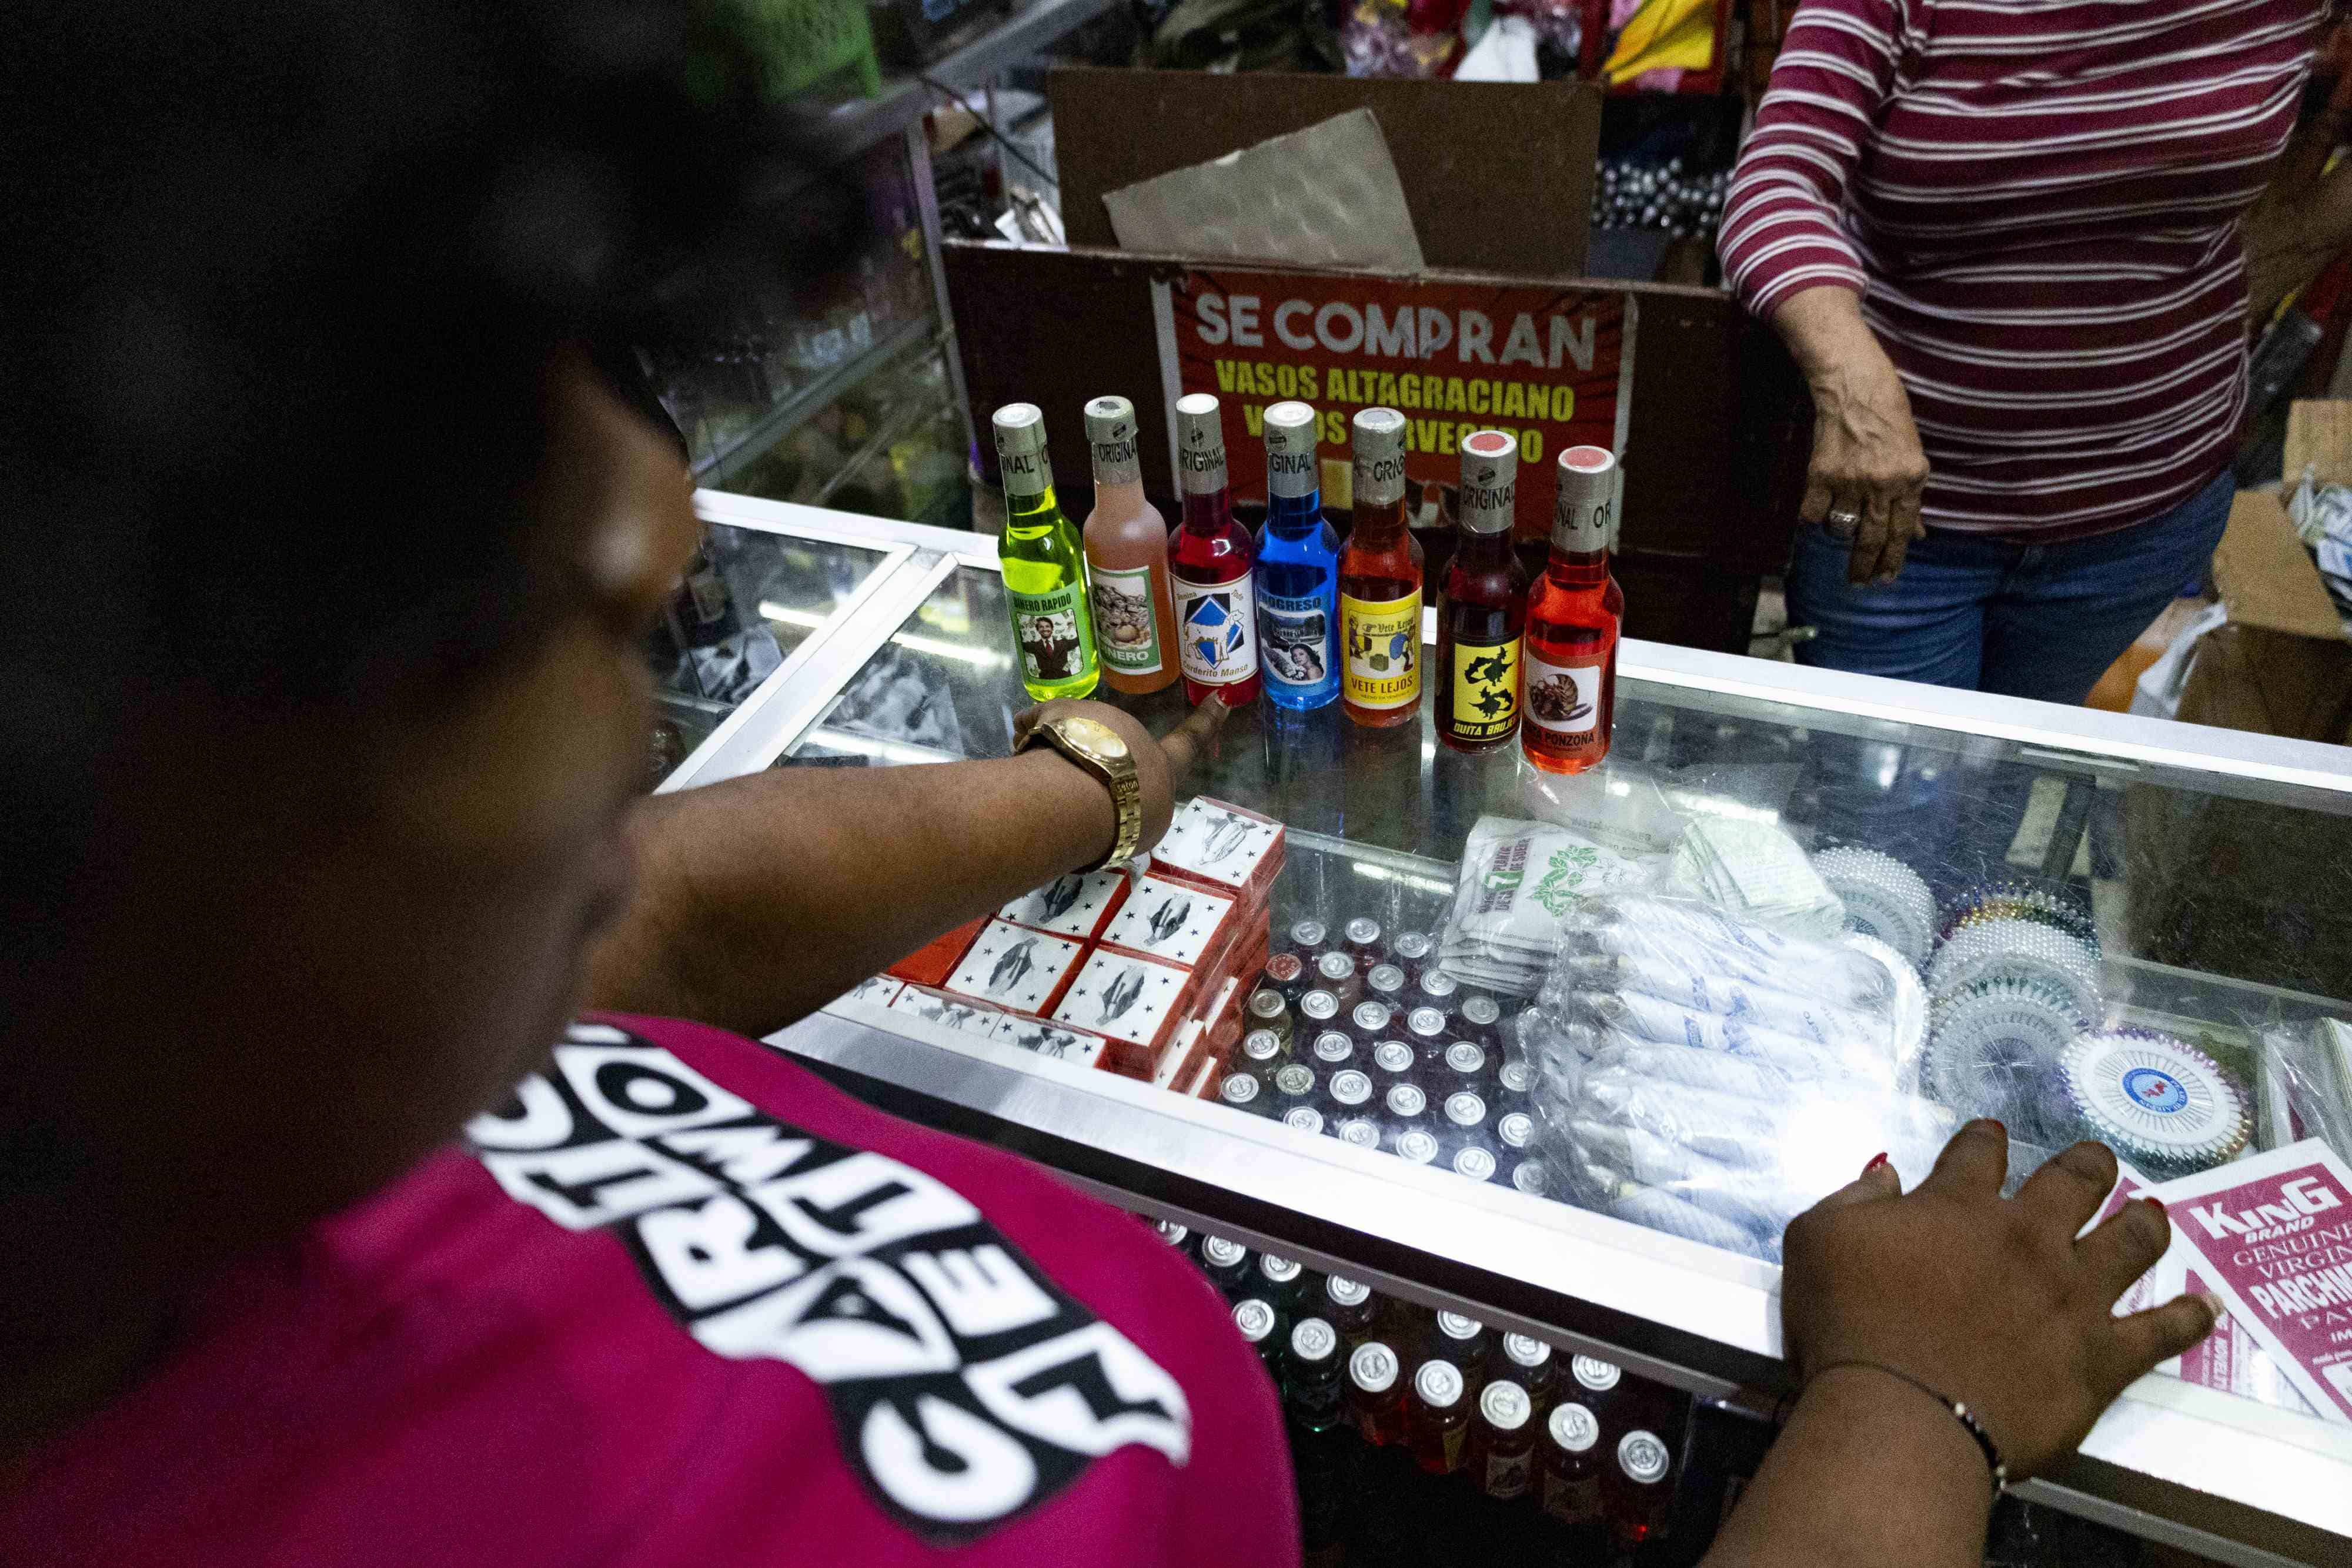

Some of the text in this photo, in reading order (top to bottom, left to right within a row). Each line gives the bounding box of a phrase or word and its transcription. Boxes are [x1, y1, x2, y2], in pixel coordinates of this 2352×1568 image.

[1196, 294, 1596, 372] SE COMPRAN
[1215, 359, 1575, 422] VASOS ALTAGRACIANO
[1180, 447, 1224, 472] RIGINAL
[1041, 593, 1071, 611] RAPIDO
[1350, 674, 1413, 694] VETE LEJOS
[2187, 1176, 2343, 1240] KING
[2244, 1215, 2315, 1245] BRAND
